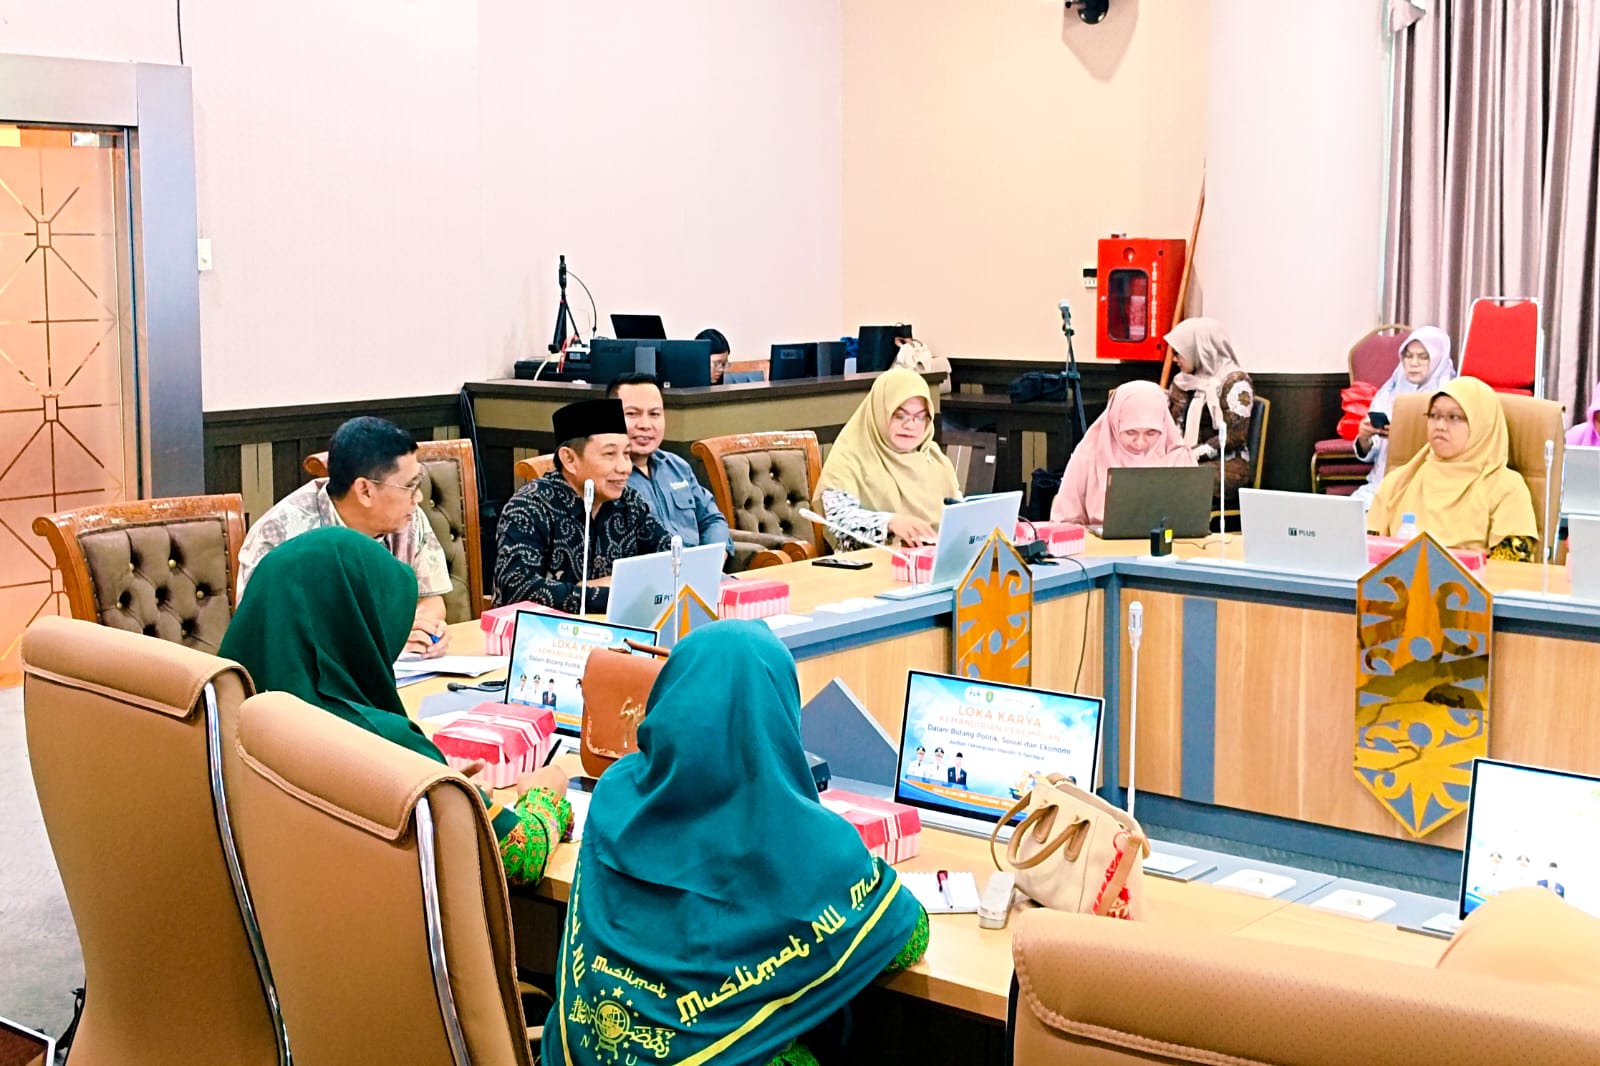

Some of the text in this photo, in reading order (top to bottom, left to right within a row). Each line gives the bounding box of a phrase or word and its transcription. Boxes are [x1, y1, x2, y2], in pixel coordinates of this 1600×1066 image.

[1288, 527, 1316, 537] IT PLUS
[552, 639, 577, 650] LOKA
[958, 705, 1042, 728] LOKA KARYA
[927, 724, 949, 733] Dalam
[950, 728, 975, 739] Bidang
[1001, 736, 1022, 747] Sosial
[1039, 743, 1072, 755] Ekonomi
[591, 955, 667, 1000] Muslimat
[675, 934, 810, 1027] Muslimat
